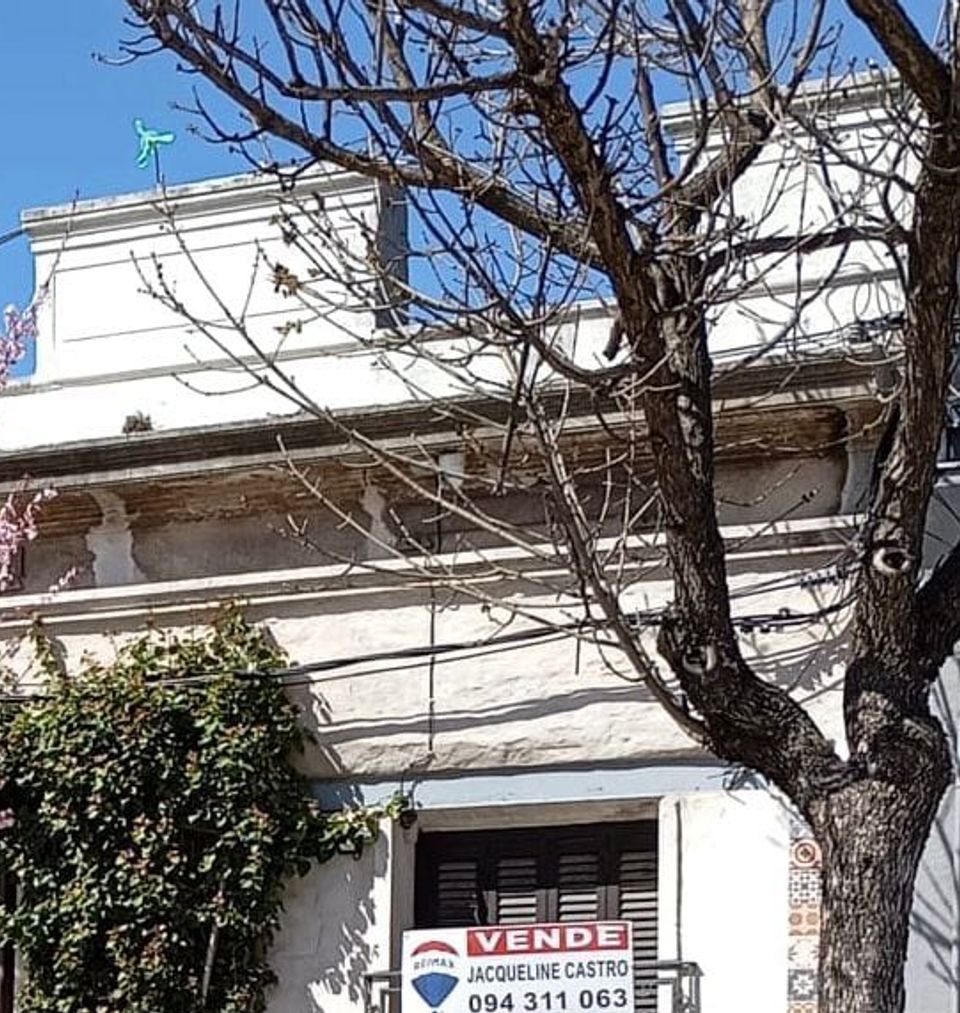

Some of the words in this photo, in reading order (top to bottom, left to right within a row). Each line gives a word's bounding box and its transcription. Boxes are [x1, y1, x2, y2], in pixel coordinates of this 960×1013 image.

[474, 925, 625, 951] VENDE
[413, 957, 455, 970] RE/MAX
[467, 964, 560, 984] JACQUELINE
[565, 960, 629, 979] CASTRO
[468, 992, 514, 1013] 094
[524, 990, 567, 1011] 311
[580, 988, 627, 1009] 063
